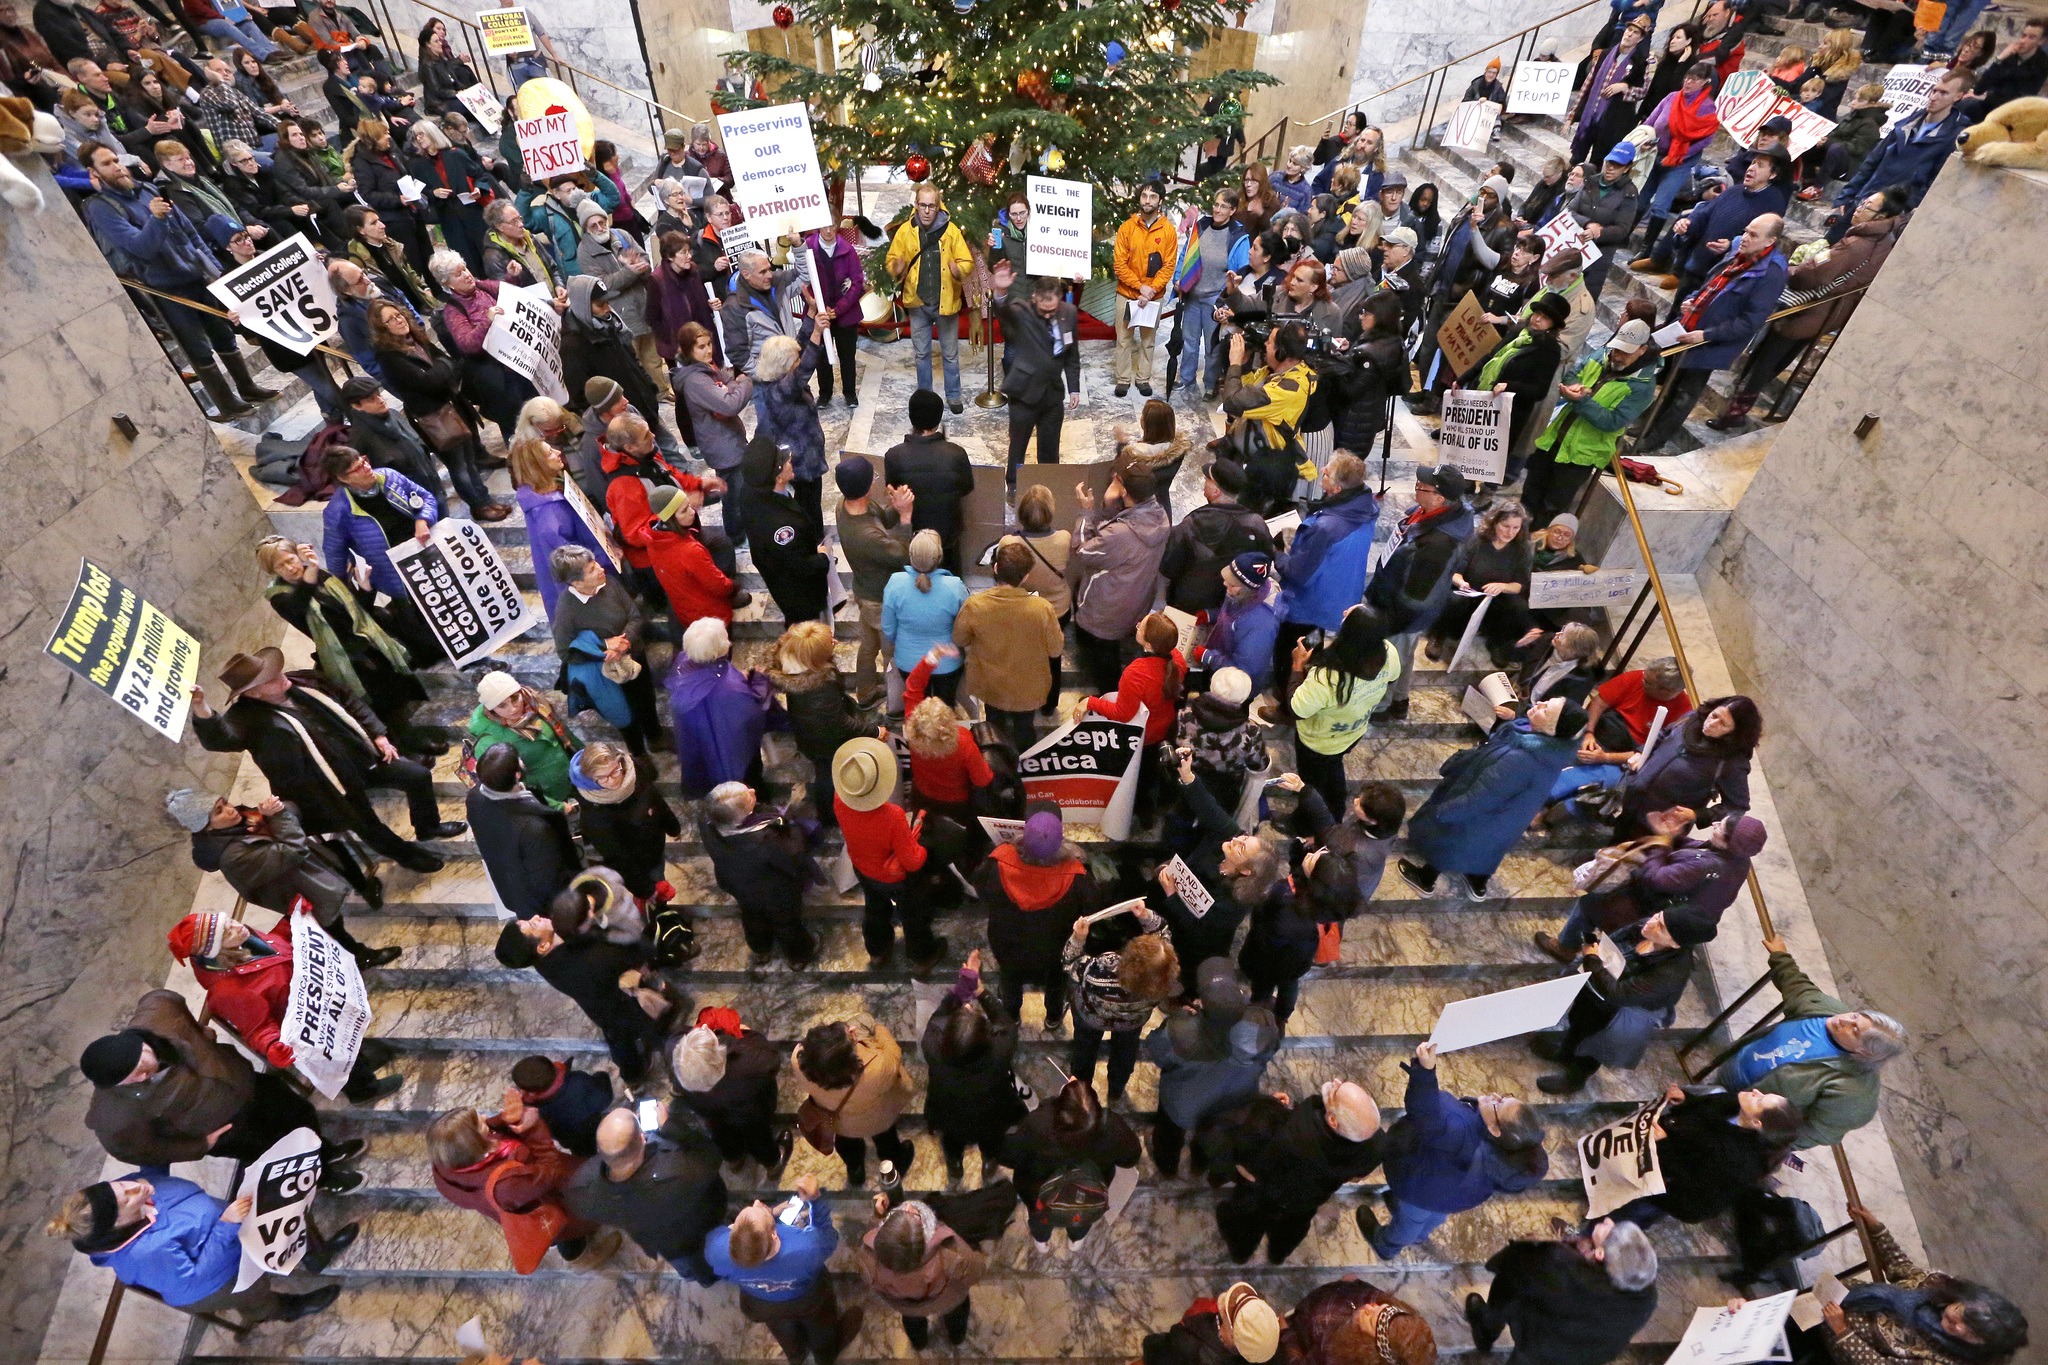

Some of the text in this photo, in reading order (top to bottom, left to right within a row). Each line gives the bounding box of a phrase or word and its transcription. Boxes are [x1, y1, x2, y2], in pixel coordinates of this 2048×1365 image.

[481, 12, 523, 22] ELECTORAL
[1520, 67, 1570, 84] STOP
[1916, 72, 1940, 83] NEEDS
[1516, 90, 1561, 103] TRUMP
[1894, 102, 1913, 114] OF
[1897, 94, 1920, 104] STAND
[517, 114, 566, 139] NOT MY
[723, 116, 803, 138] Preserving
[1442, 102, 1482, 146] NO
[522, 139, 579, 175] FASCIST
[754, 144, 781, 157] OUR
[742, 163, 807, 182] democracy
[774, 184, 784, 193] is
[1035, 184, 1080, 198] FEEL THE
[747, 193, 821, 219] PATRIOTIC
[1035, 203, 1080, 219] WEIGHT
[1058, 228, 1079, 237] YOUR
[1030, 244, 1088, 259] CONSCIENCE
[233, 250, 305, 296] Electoral College:
[255, 271, 309, 318] SAVE
[266, 294, 339, 343] U.S.
[518, 318, 536, 335] WHO
[1461, 307, 1487, 342] LOVE
[509, 321, 534, 346] FOR
[534, 341, 549, 364] ALL
[549, 360, 560, 375] OF
[1446, 333, 1466, 360] HATE
[1470, 399, 1488, 408] NEEDS
[1445, 407, 1500, 427] PRESIDENT
[1446, 424, 1457, 432] WHO
[1465, 427, 1484, 435] STAND
[1441, 433, 1499, 452] FOR ALL OF US
[444, 535, 506, 634] Vote Your
[1608, 587, 1632, 598] LOST
[406, 559, 470, 654] ELECTORAL
[429, 559, 479, 636] COLLEGE:
[51, 562, 111, 664] Trump lost
[89, 588, 137, 687] the popular vote
[131, 657, 155, 689] 2.8
[154, 636, 191, 729] and growing...
[121, 684, 149, 712] By
[1017, 752, 1098, 773] erica
[1038, 791, 1055, 799] Can
[1174, 861, 1212, 905] SEND IT
[295, 973, 309, 1025] AMERICA
[300, 926, 325, 1048] PRESIDENT
[322, 943, 347, 1061] FOR ALL OF US
[317, 1018, 326, 1045] WHO
[323, 992, 333, 1018] WILL
[267, 1154, 321, 1181] ELE
